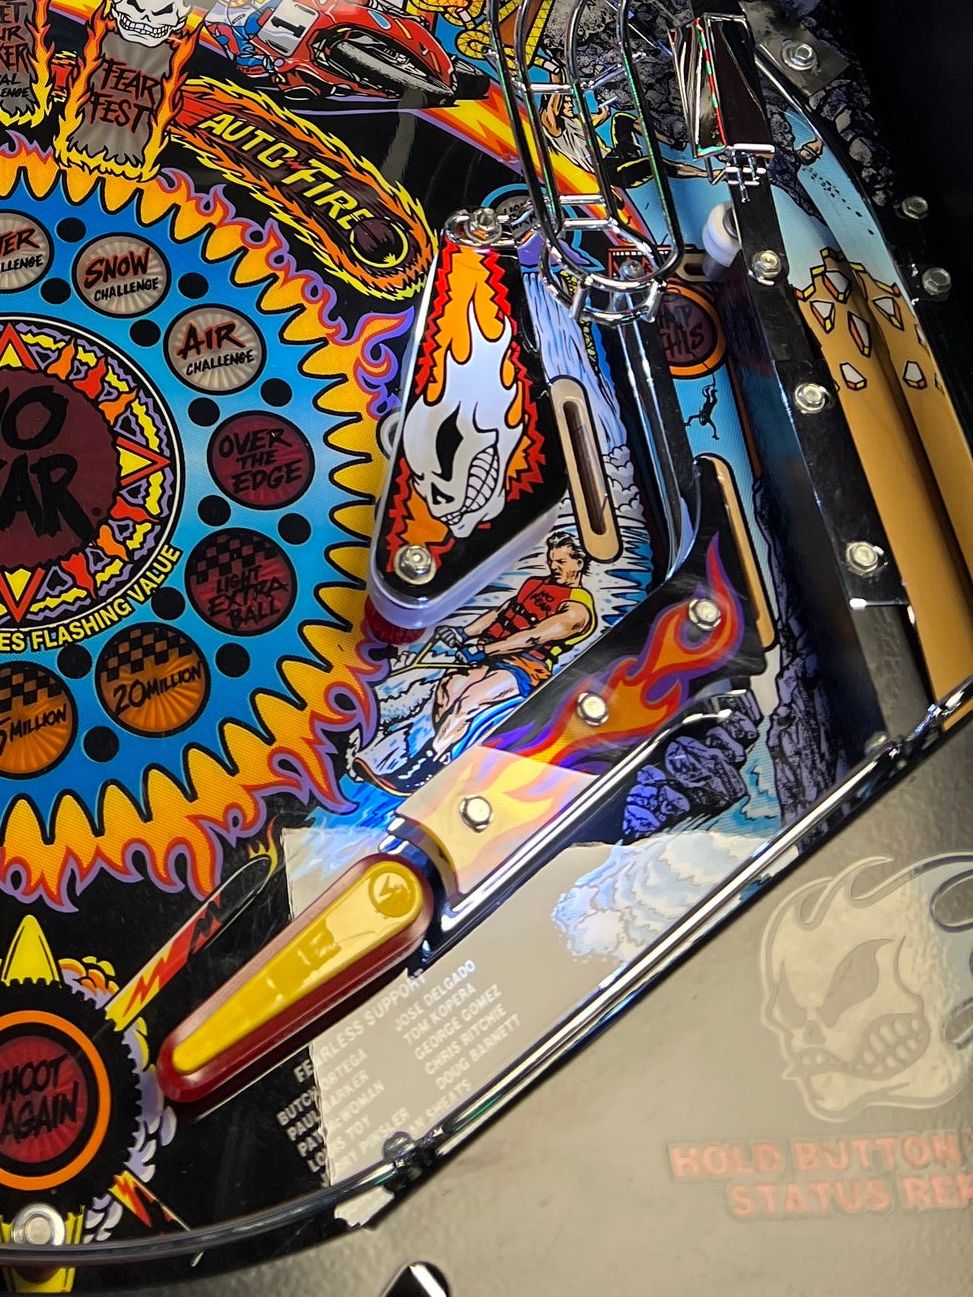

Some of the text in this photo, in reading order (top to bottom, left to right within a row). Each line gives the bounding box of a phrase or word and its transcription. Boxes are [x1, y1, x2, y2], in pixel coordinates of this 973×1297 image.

[271, 15, 307, 39] 1
[101, 58, 161, 101] FEAR
[87, 92, 149, 133] TEST
[83, 247, 151, 290] SNOW
[93, 277, 160, 302] CHALLENGE
[177, 320, 246, 360] AIR
[185, 349, 256, 376] CHALLENGE
[218, 427, 292, 458] OVER
[235, 450, 278, 471] THE
[231, 460, 303, 494] EDGE
[32, 599, 133, 649] FLASHING
[128, 545, 180, 606] VALUE
[215, 565, 263, 595] LIGHT
[229, 600, 281, 631] BALL
[113, 662, 203, 715] 20 MILLION
[9, 704, 67, 742] MILLION
[395, 959, 476, 1032] JOSE DELGADO
[403, 983, 477, 1046] TOM KOPERA
[293, 969, 427, 1083] FEARLESS SUPPORT
[414, 984, 503, 1061] GEORGE GOMEZ
[424, 1003, 508, 1076] CHRIS RITCHIE
[435, 1013, 521, 1091] DOUG BARNETT
[670, 1133, 961, 1179] HOLD BUTTON
[728, 1178, 891, 1217] STATUS
